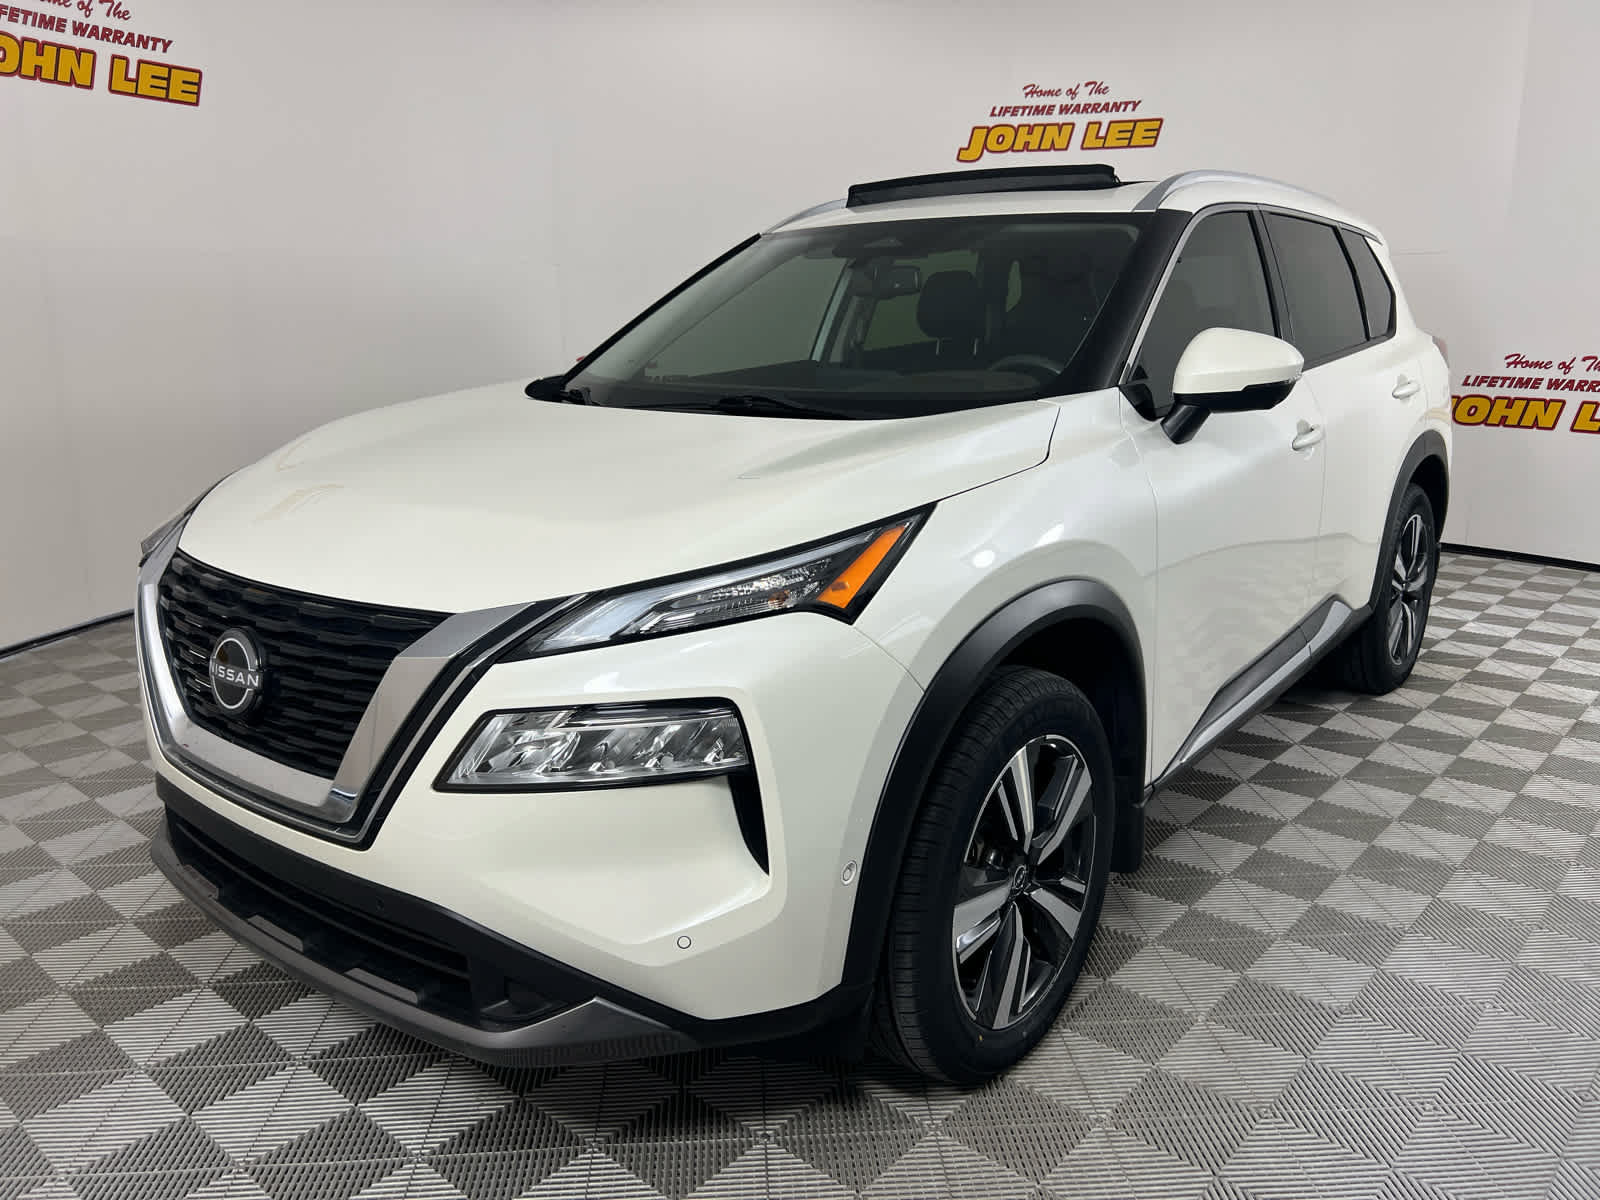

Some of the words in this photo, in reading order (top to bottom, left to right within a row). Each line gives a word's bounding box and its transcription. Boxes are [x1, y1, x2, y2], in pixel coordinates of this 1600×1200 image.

[77, 0, 93, 18] of
[99, 0, 131, 20] The
[0, 4, 67, 33] FETIME
[72, 20, 173, 53] WARRANTY
[0, 30, 97, 90] OHN
[108, 53, 203, 107] LEE
[1022, 83, 1062, 98] Home
[1065, 83, 1081, 100] of
[1084, 80, 1110, 96] The
[989, 104, 1056, 117] LIFETIME
[1058, 100, 1142, 115] WARRANTY
[956, 122, 1075, 163] JOHN
[1080, 118, 1164, 150] LEE
[1504, 353, 1553, 370] Home
[1557, 356, 1576, 375] of
[1461, 375, 1544, 390] LIFETIME
[1546, 378, 1600, 392] WARR
